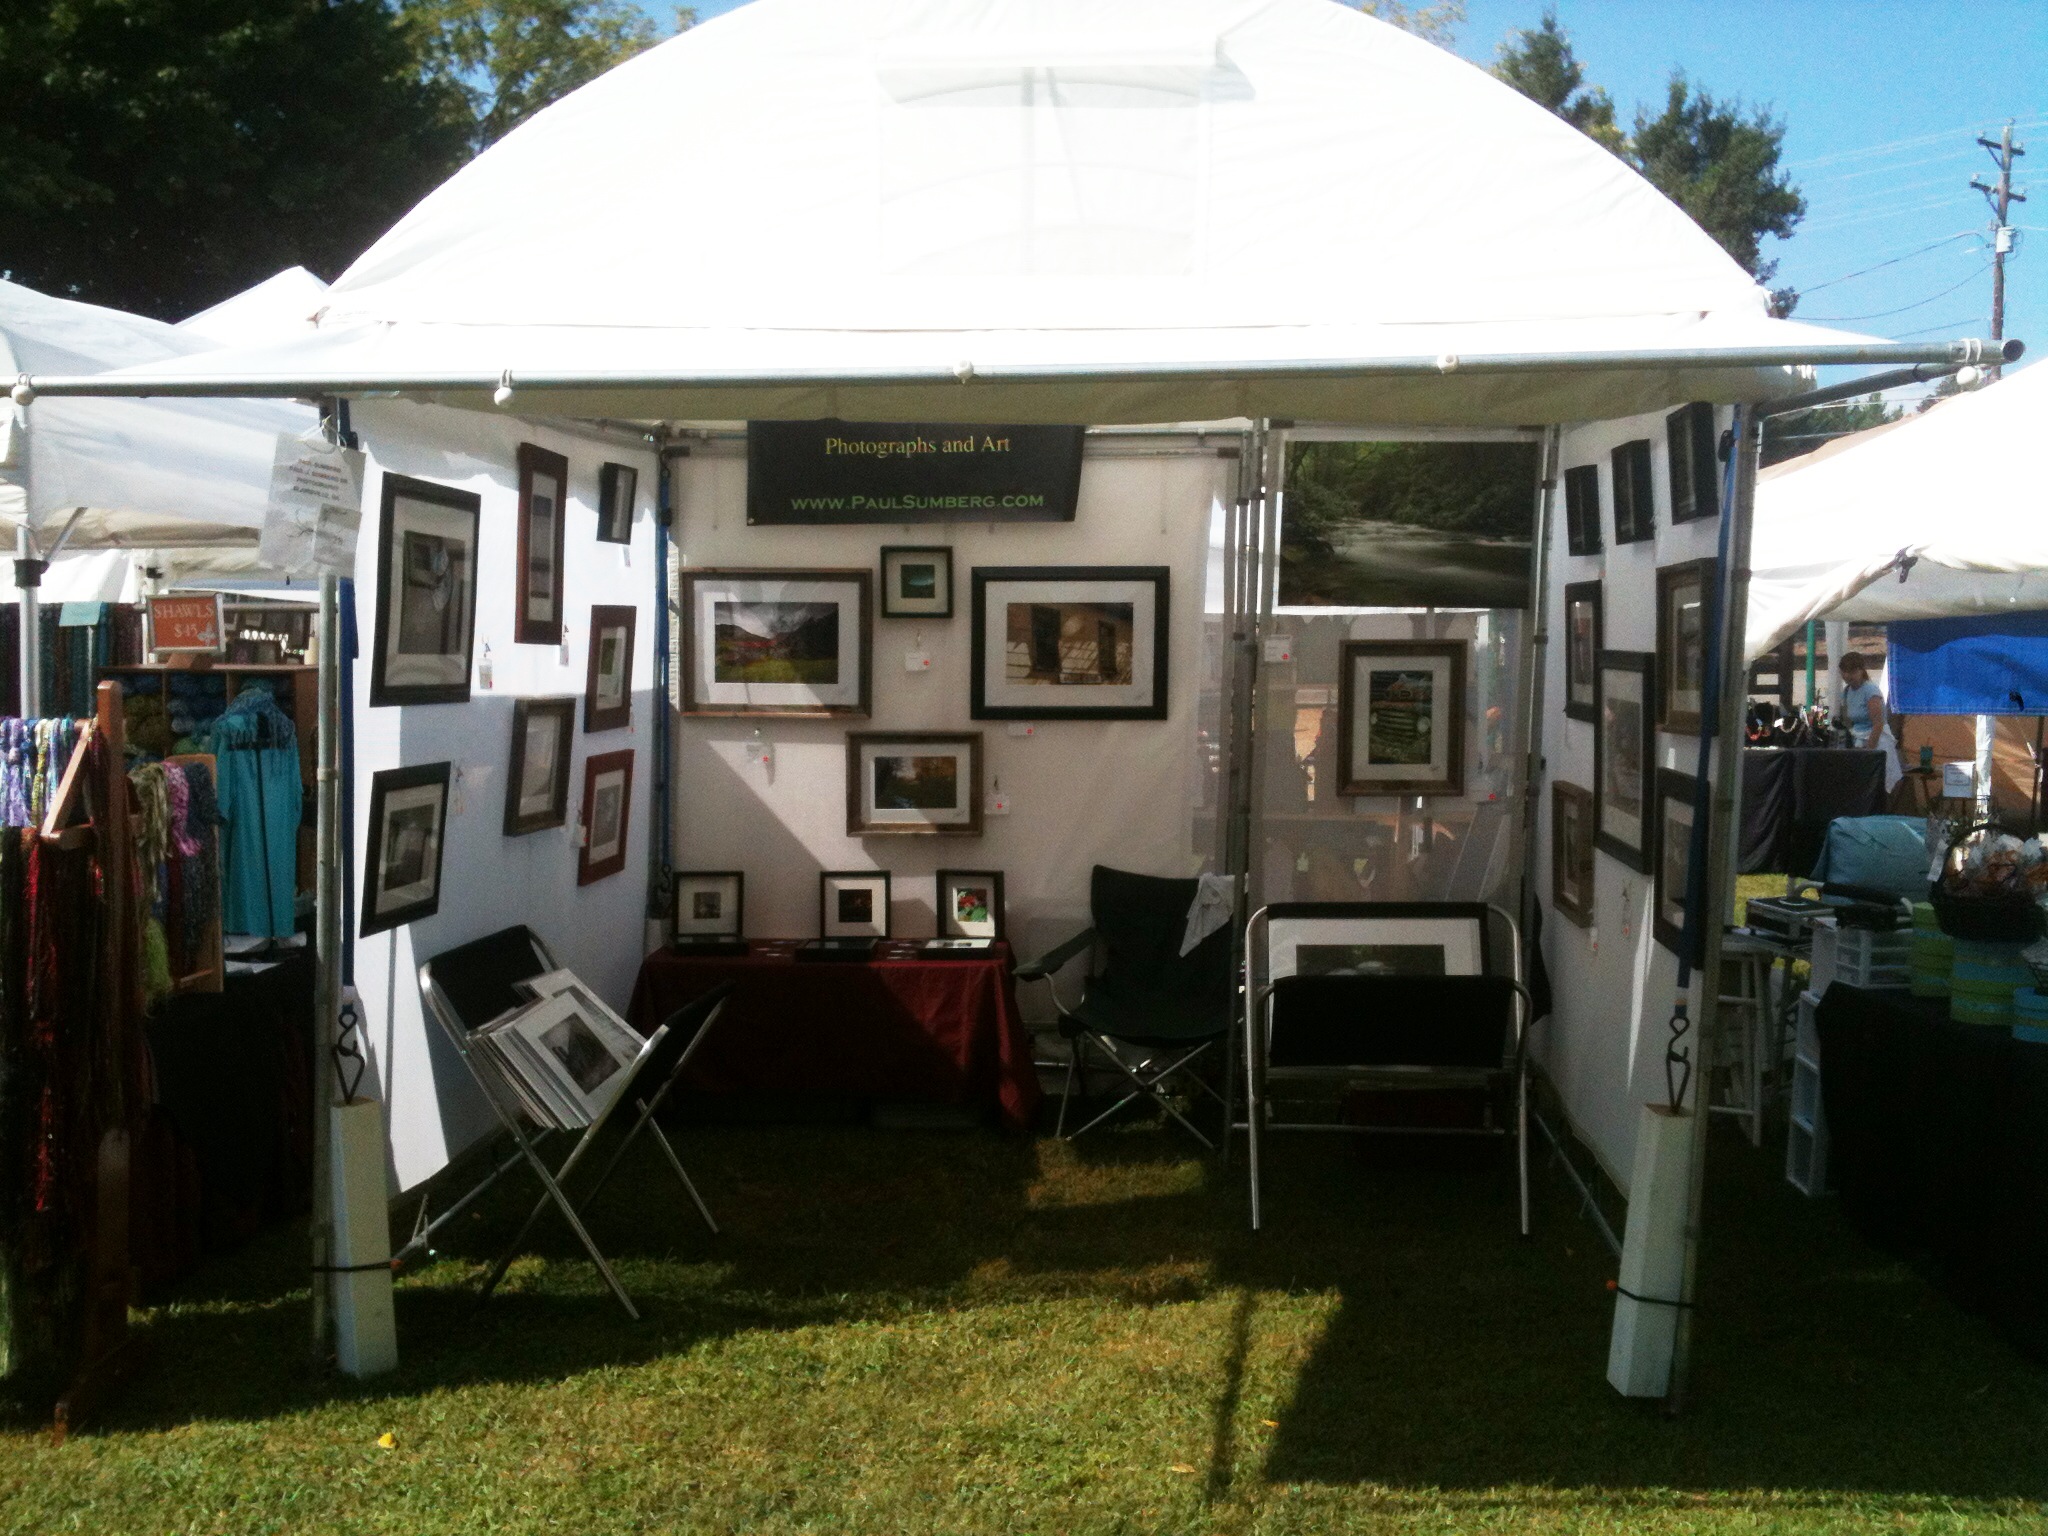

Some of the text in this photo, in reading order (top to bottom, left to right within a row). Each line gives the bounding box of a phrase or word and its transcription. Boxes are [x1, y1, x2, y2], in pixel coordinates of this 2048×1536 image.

[825, 436, 1011, 459] Photographs and Art
[153, 603, 215, 619] SHAWLS
